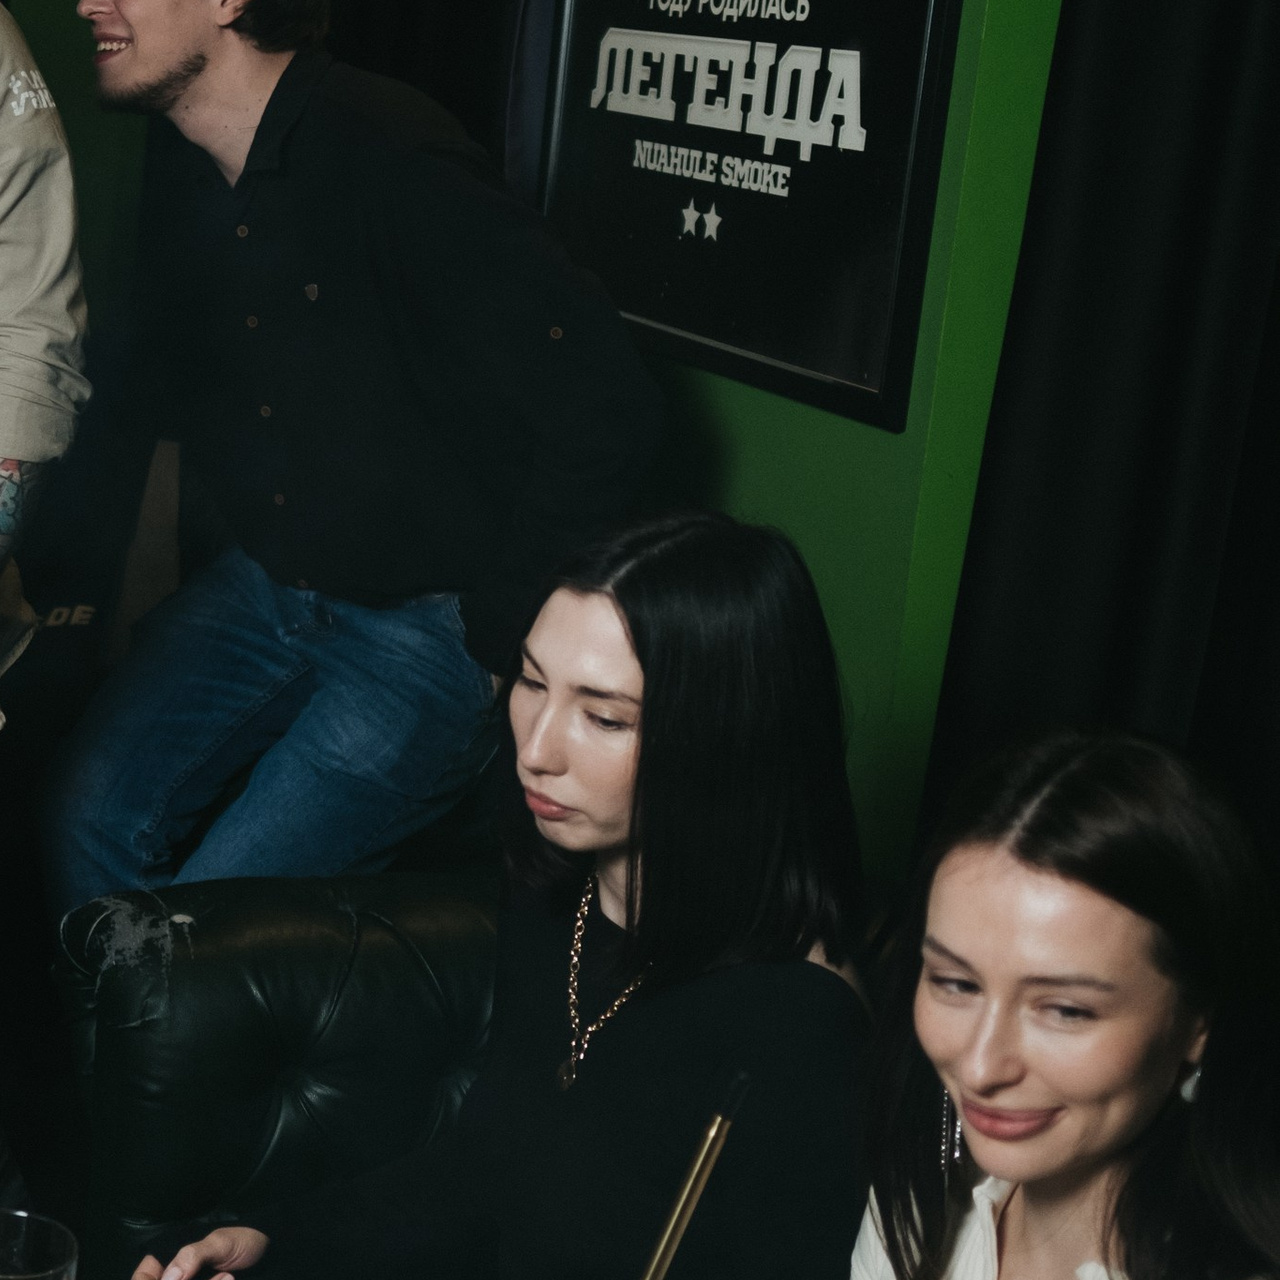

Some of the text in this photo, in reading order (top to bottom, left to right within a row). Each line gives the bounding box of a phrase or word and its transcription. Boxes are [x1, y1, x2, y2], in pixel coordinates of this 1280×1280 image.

[590, 27, 867, 162] ЛЕГЕНДА
[633, 139, 791, 198] NUAHULE SMOKE
